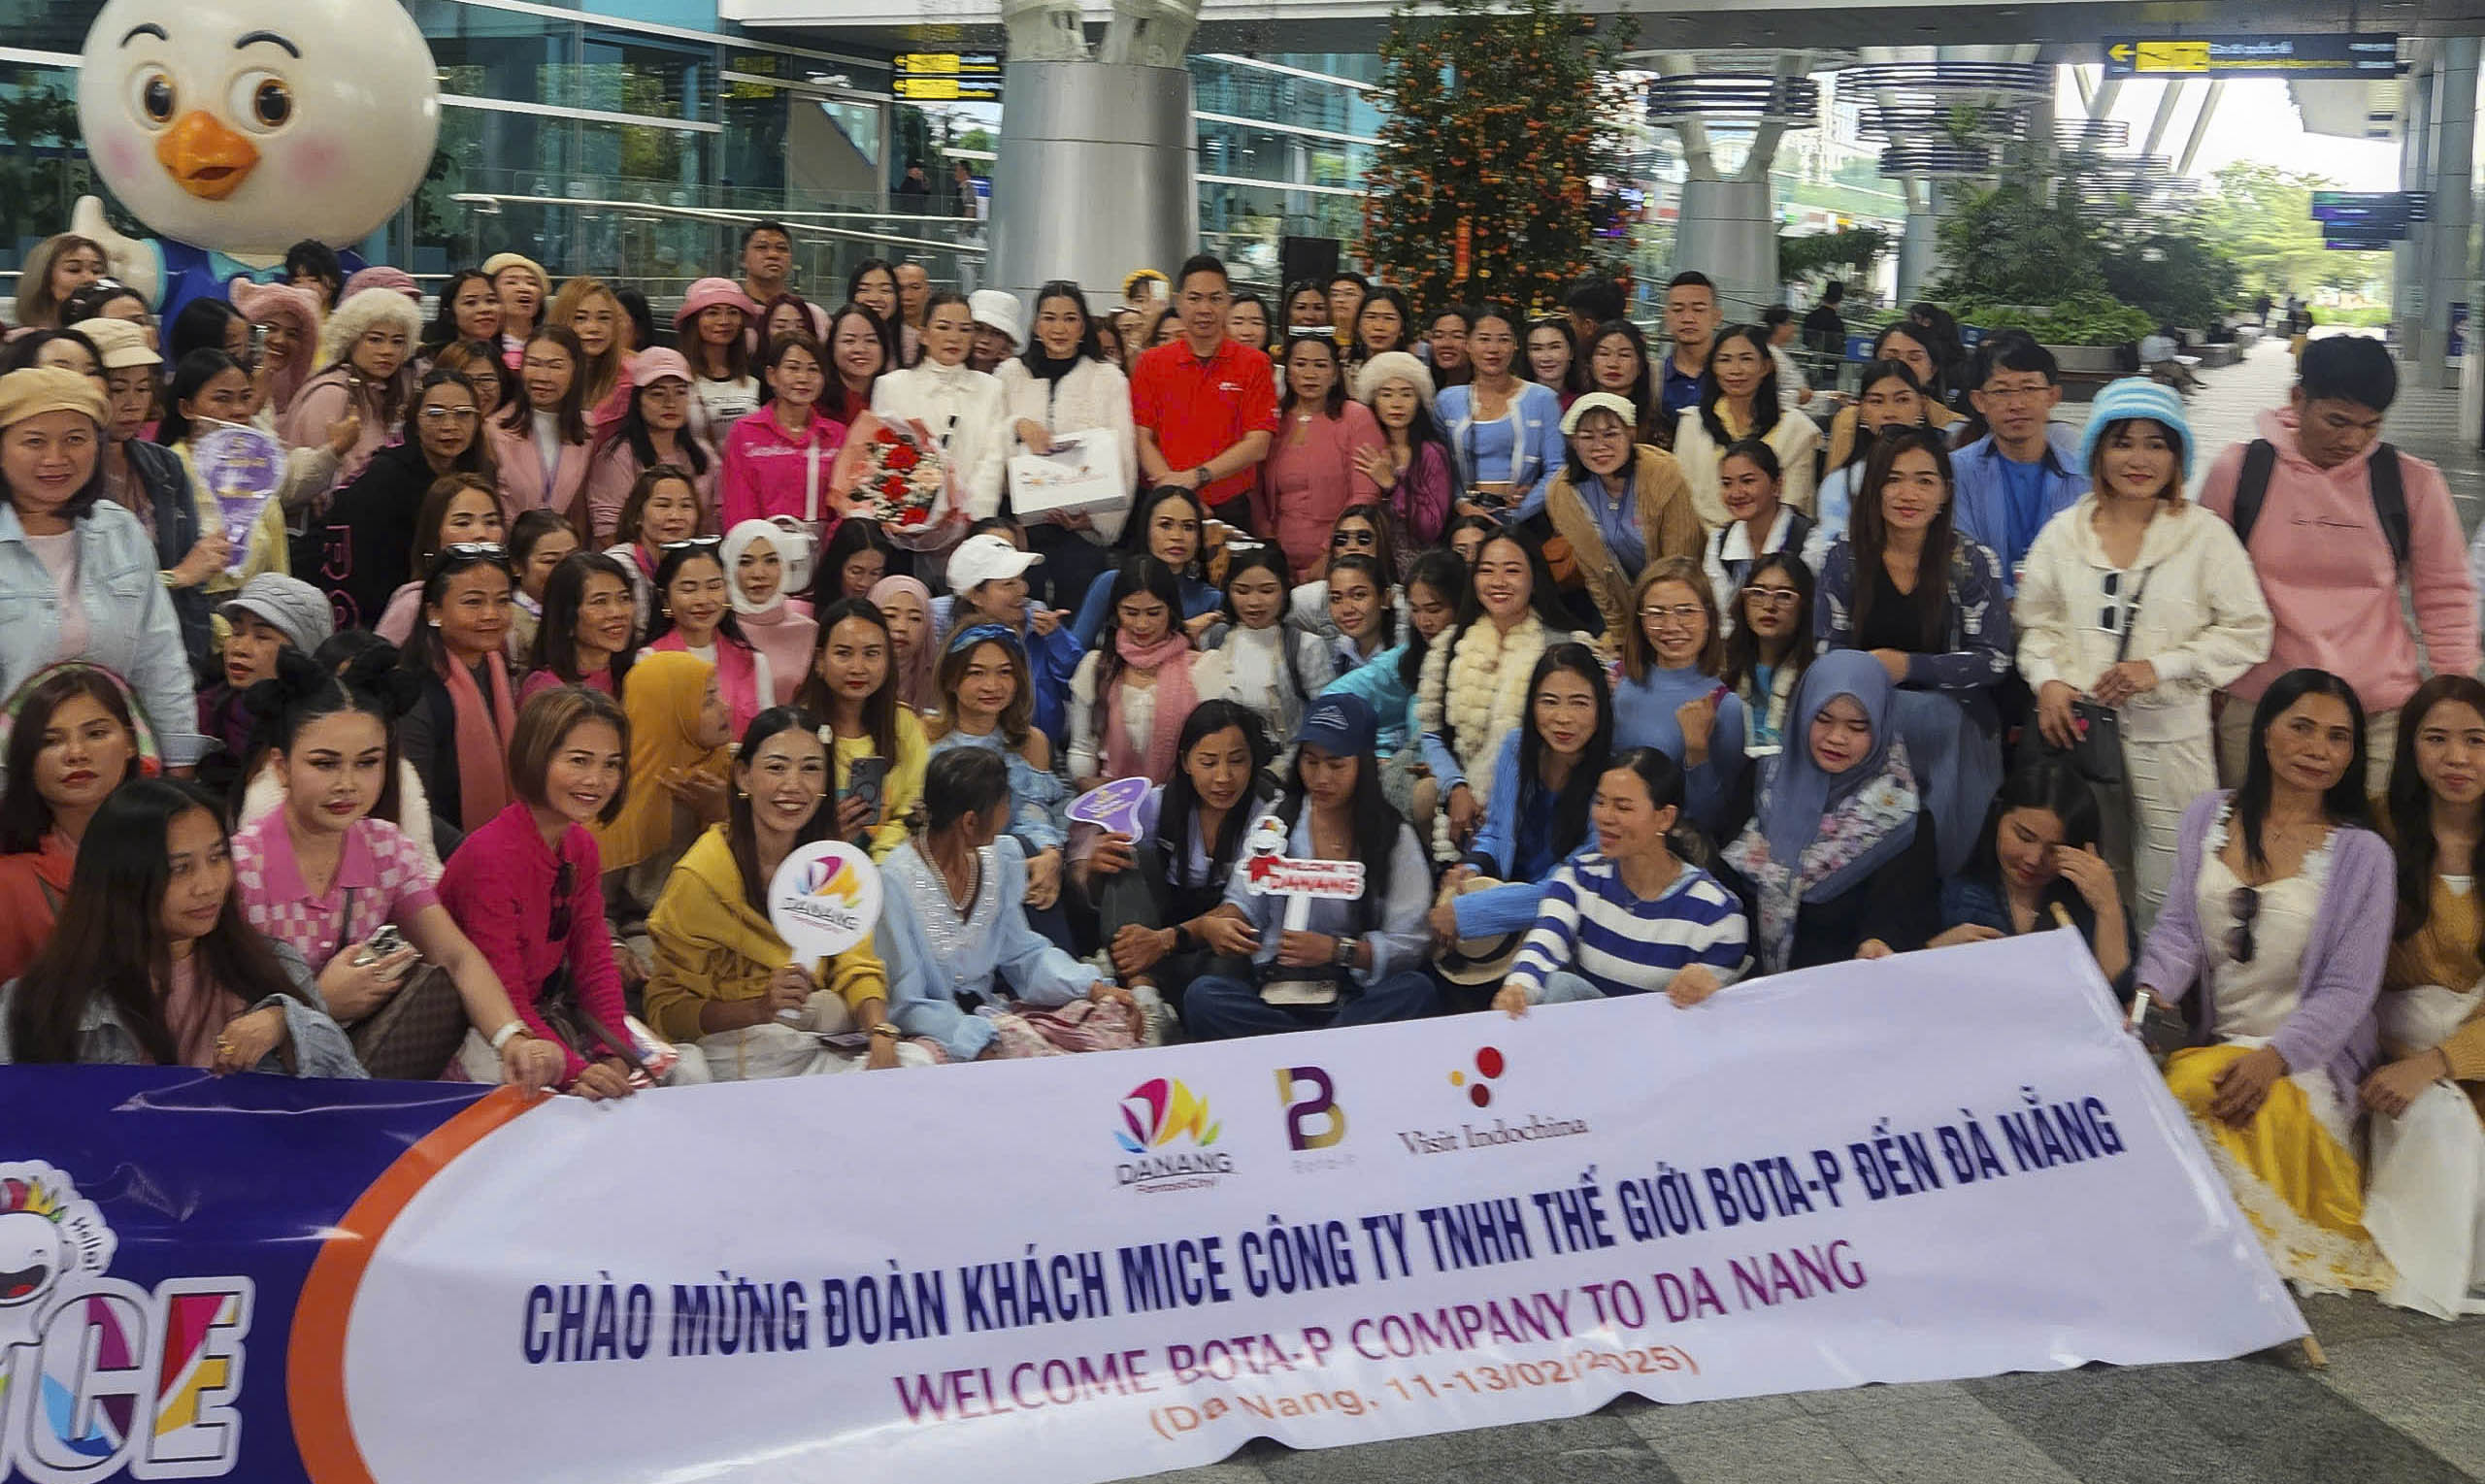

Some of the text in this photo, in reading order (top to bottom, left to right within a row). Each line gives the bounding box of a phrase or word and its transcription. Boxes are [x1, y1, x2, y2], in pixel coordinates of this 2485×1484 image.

[1270, 874, 1360, 894] DANANG
[1397, 1115, 1591, 1154] Visit Indochina
[1117, 1152, 1231, 1185] DANANG
[523, 1085, 2128, 1364] CHÀO MỪNG ĐOÀN KHÁCH MICE CÔNG TY TNHH THẾ GIỚI BOTA-P ĐẾN ĐÀ NẴNG
[893, 1238, 1869, 1424] WELCOME BOTA-P COMPANY TO DA NANG
[1149, 1396, 1231, 1441] (Da
[1382, 1345, 1701, 1402] 11-13/02/2025)
